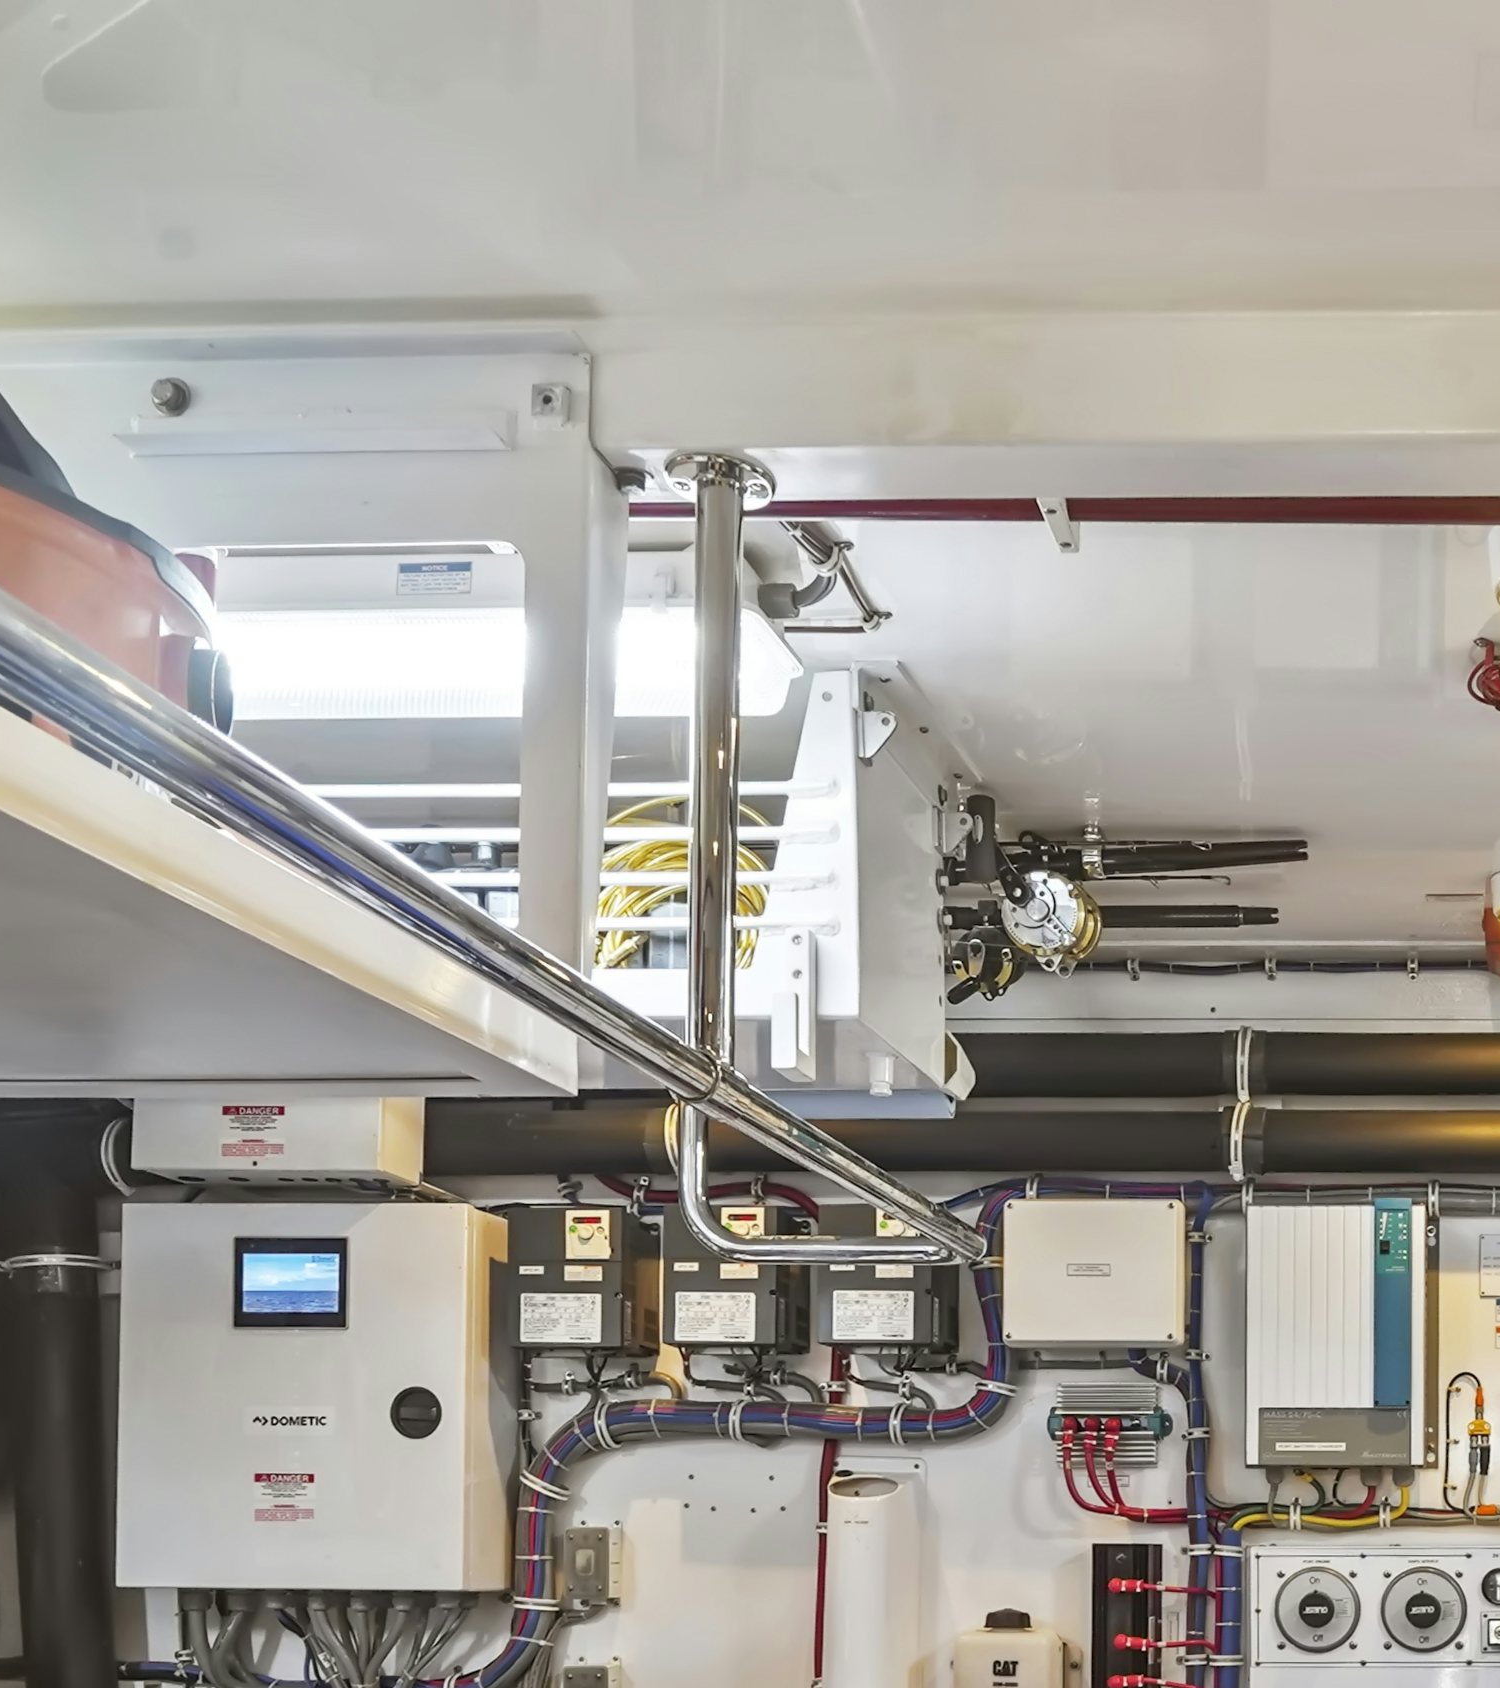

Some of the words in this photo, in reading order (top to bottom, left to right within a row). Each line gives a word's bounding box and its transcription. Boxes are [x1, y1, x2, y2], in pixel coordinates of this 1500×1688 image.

[421, 564, 448, 572] NOTICE
[239, 1107, 279, 1115] DANGER
[270, 1416, 327, 1426] DOMETIC
[270, 1474, 309, 1483] DANGER
[1309, 1576, 1320, 1584] On
[1417, 1578, 1428, 1586] On
[1312, 1634, 1324, 1642] Off
[1418, 1635, 1430, 1643] Off
[992, 1660, 1018, 1677] CAT
